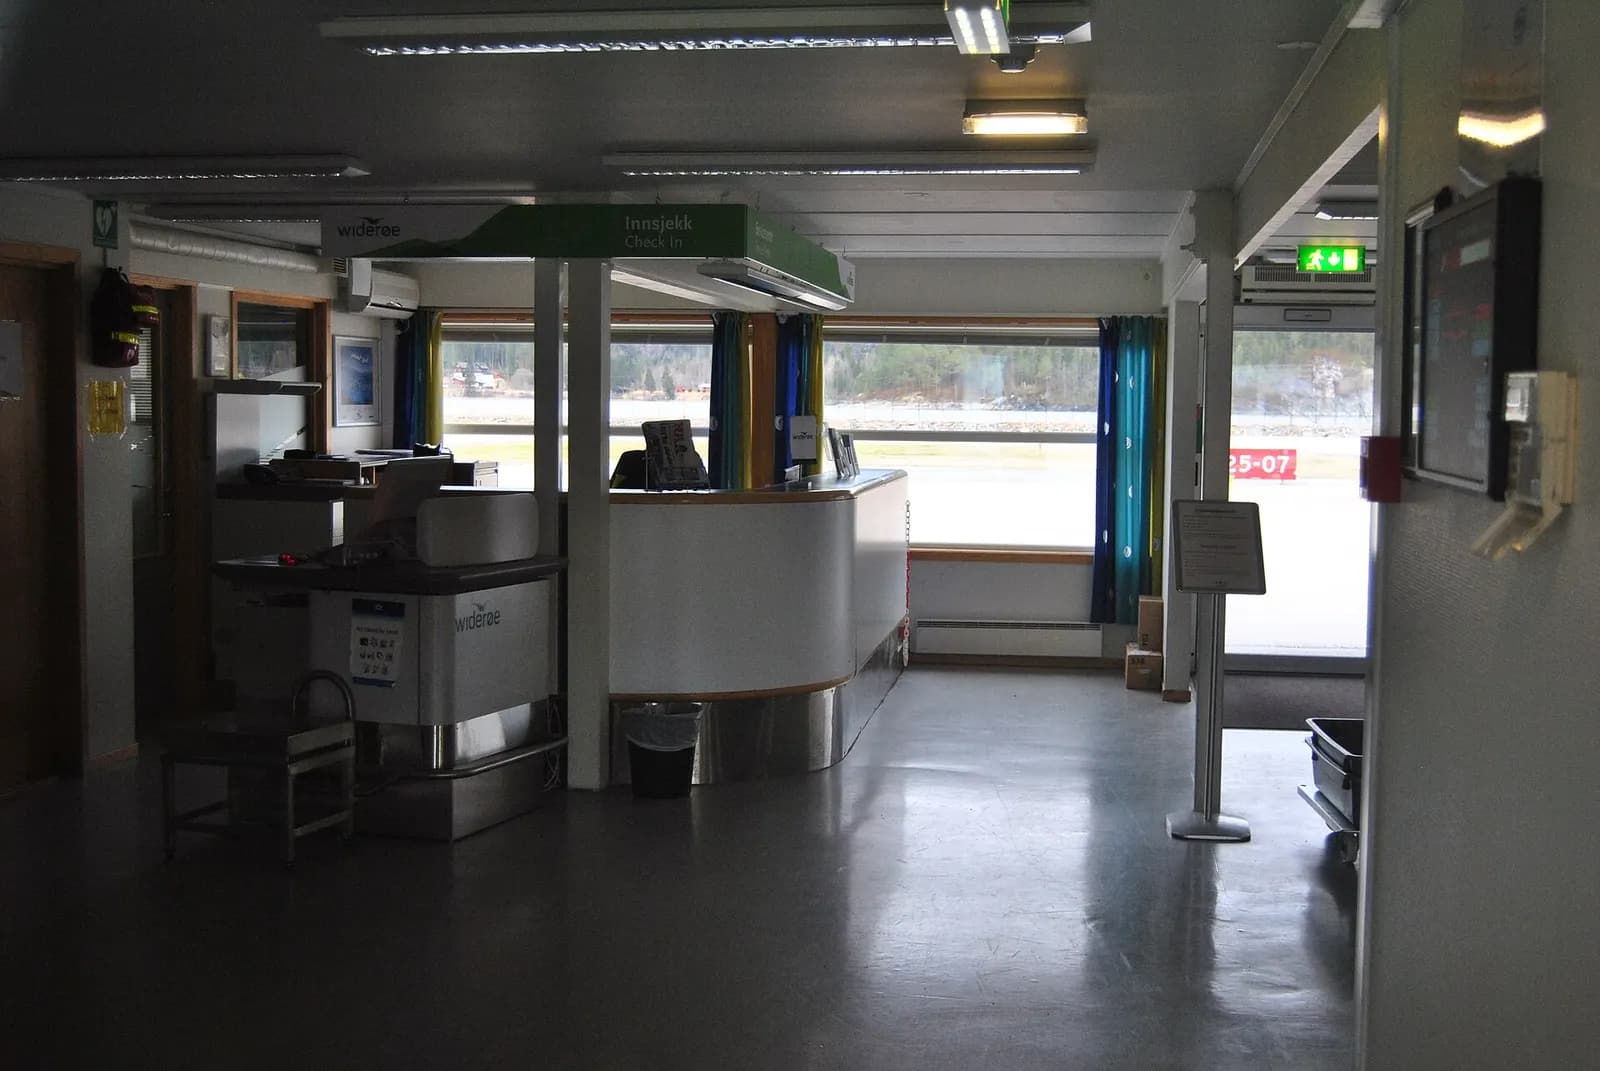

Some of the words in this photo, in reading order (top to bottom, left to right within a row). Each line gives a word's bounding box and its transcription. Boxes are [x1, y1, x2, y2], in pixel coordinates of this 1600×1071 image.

[625, 214, 692, 234] Innsjekk
[624, 235, 665, 249] Check
[670, 235, 683, 249] In
[1229, 454, 1290, 474] 25-07
[455, 610, 501, 633] widerøe
